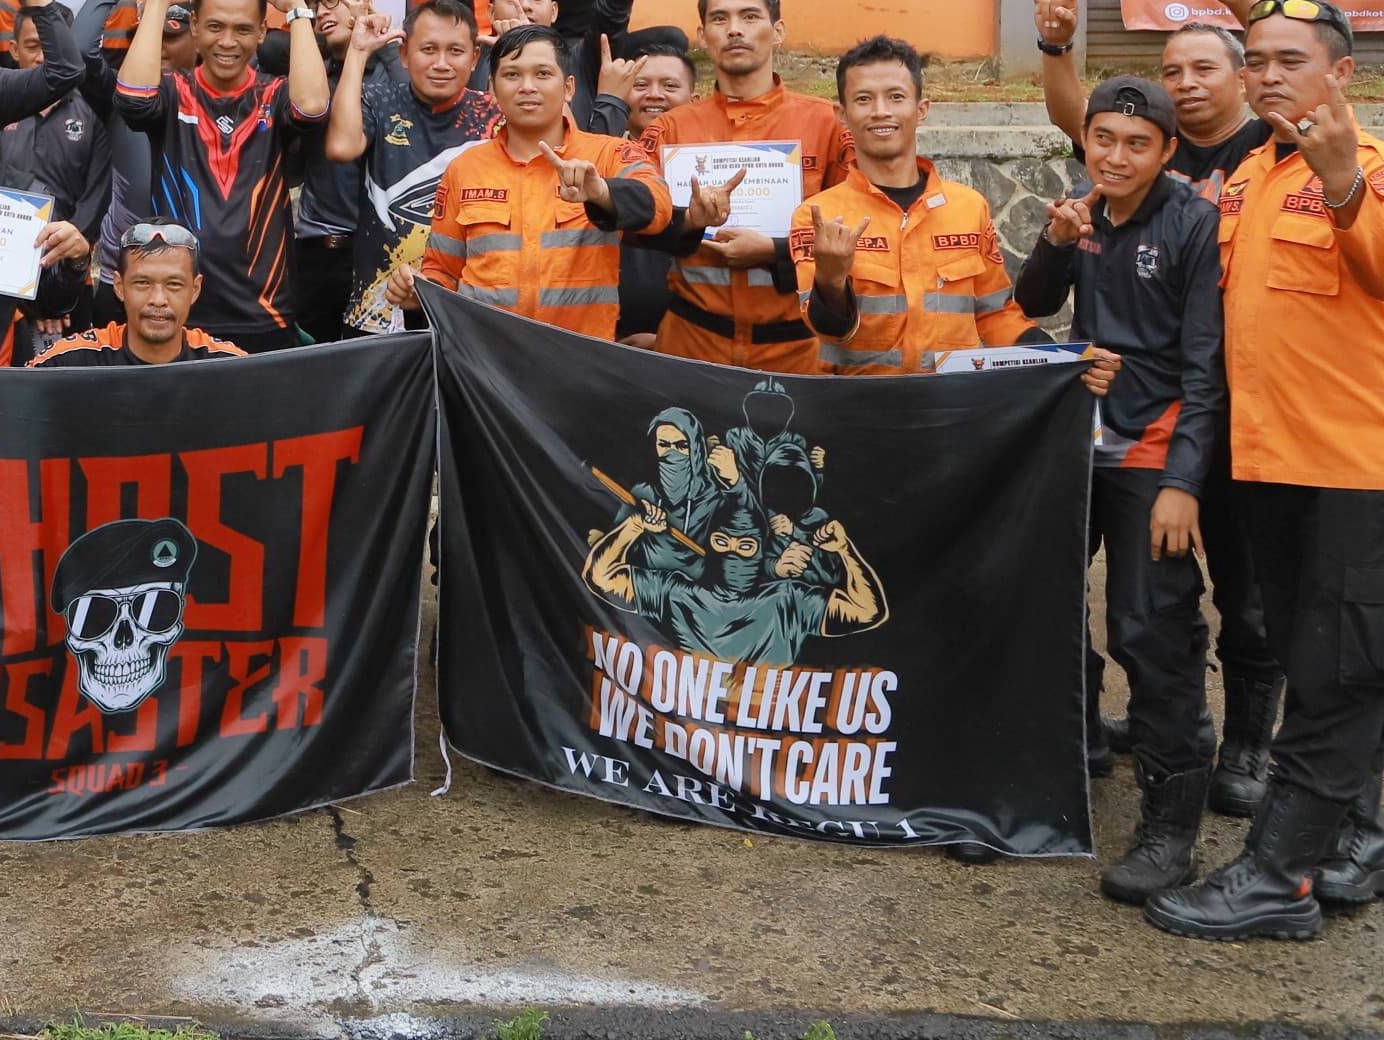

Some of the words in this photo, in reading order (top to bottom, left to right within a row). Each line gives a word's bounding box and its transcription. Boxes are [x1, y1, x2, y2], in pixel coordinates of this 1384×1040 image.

[465, 189, 505, 199] IMAM.S
[743, 177, 789, 185] EMBINAAN
[938, 234, 979, 246] BPBD
[592, 631, 644, 696] NO
[650, 650, 736, 724] ONE
[736, 666, 832, 734] LIKE
[836, 669, 898, 735] US
[598, 676, 656, 749] WE
[665, 721, 781, 802] DON'T
[784, 740, 897, 806] CARE
[47, 762, 145, 797] SQUAD
[148, 760, 168, 787] 3
[561, 746, 630, 788] WE
[643, 769, 737, 812] ARE
